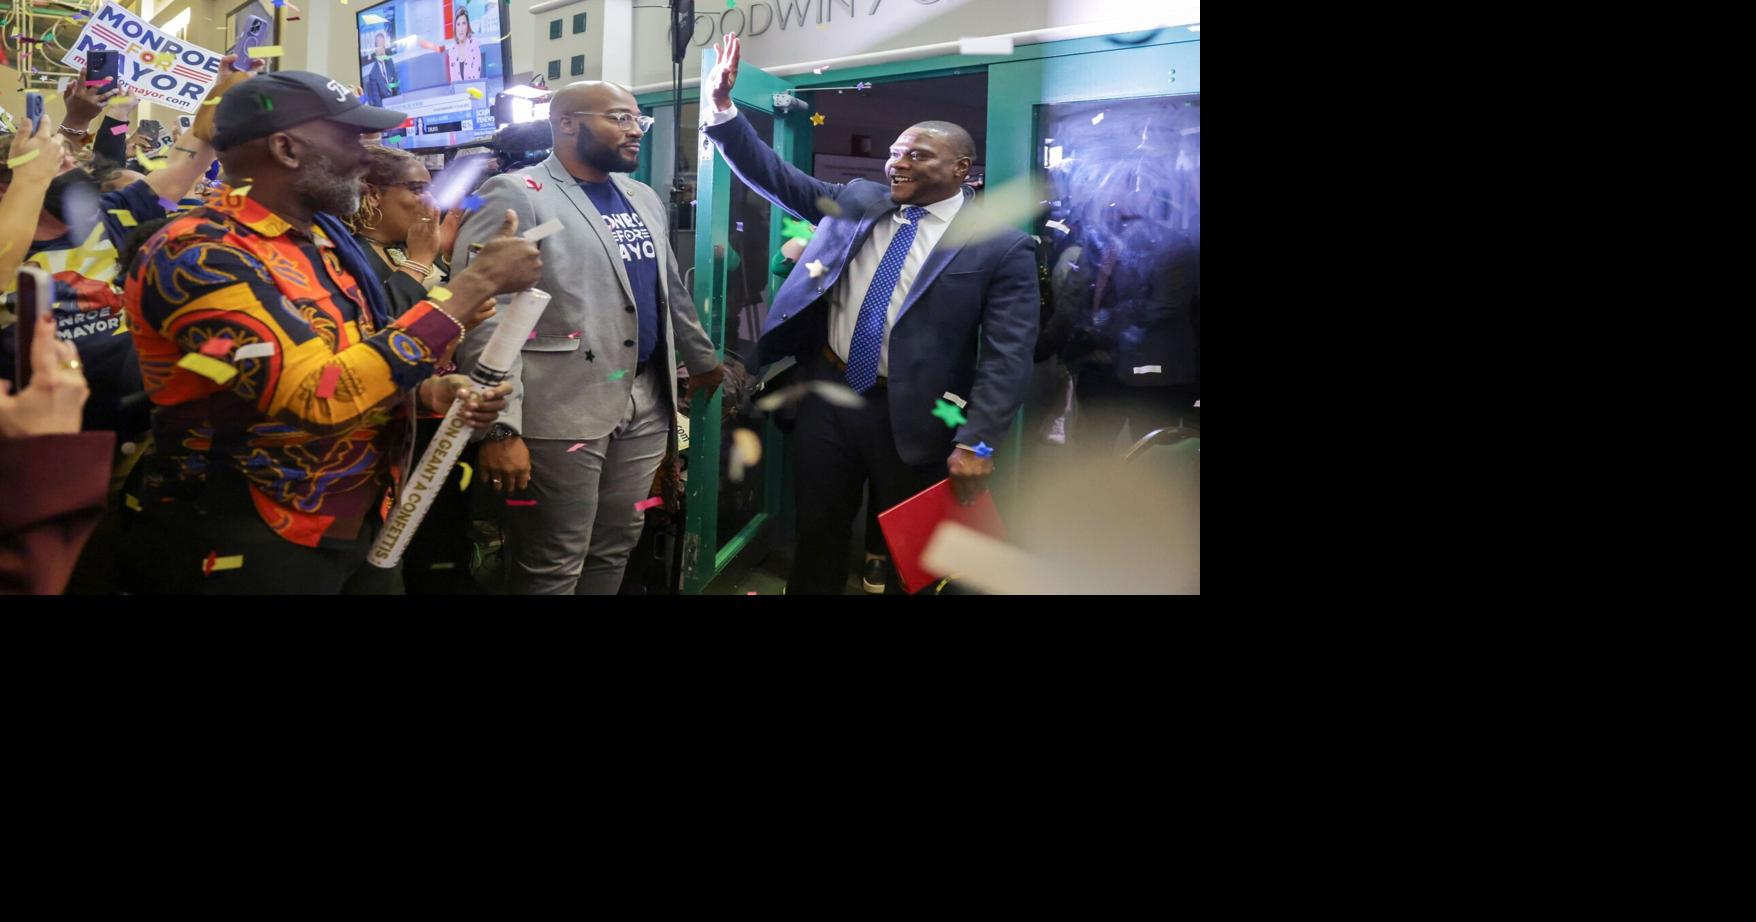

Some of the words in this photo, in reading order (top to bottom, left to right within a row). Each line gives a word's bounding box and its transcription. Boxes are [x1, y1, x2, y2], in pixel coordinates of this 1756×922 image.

[668, 0, 854, 46] OODWIN
[97, 5, 221, 73] MONROE
[618, 229, 643, 242] FOR
[619, 241, 655, 261] AYO
[59, 306, 111, 327] NROE
[56, 317, 119, 339] MAYOR
[420, 439, 452, 483] GEANT
[414, 481, 427, 491] A
[375, 493, 422, 559] CONFETTIS
